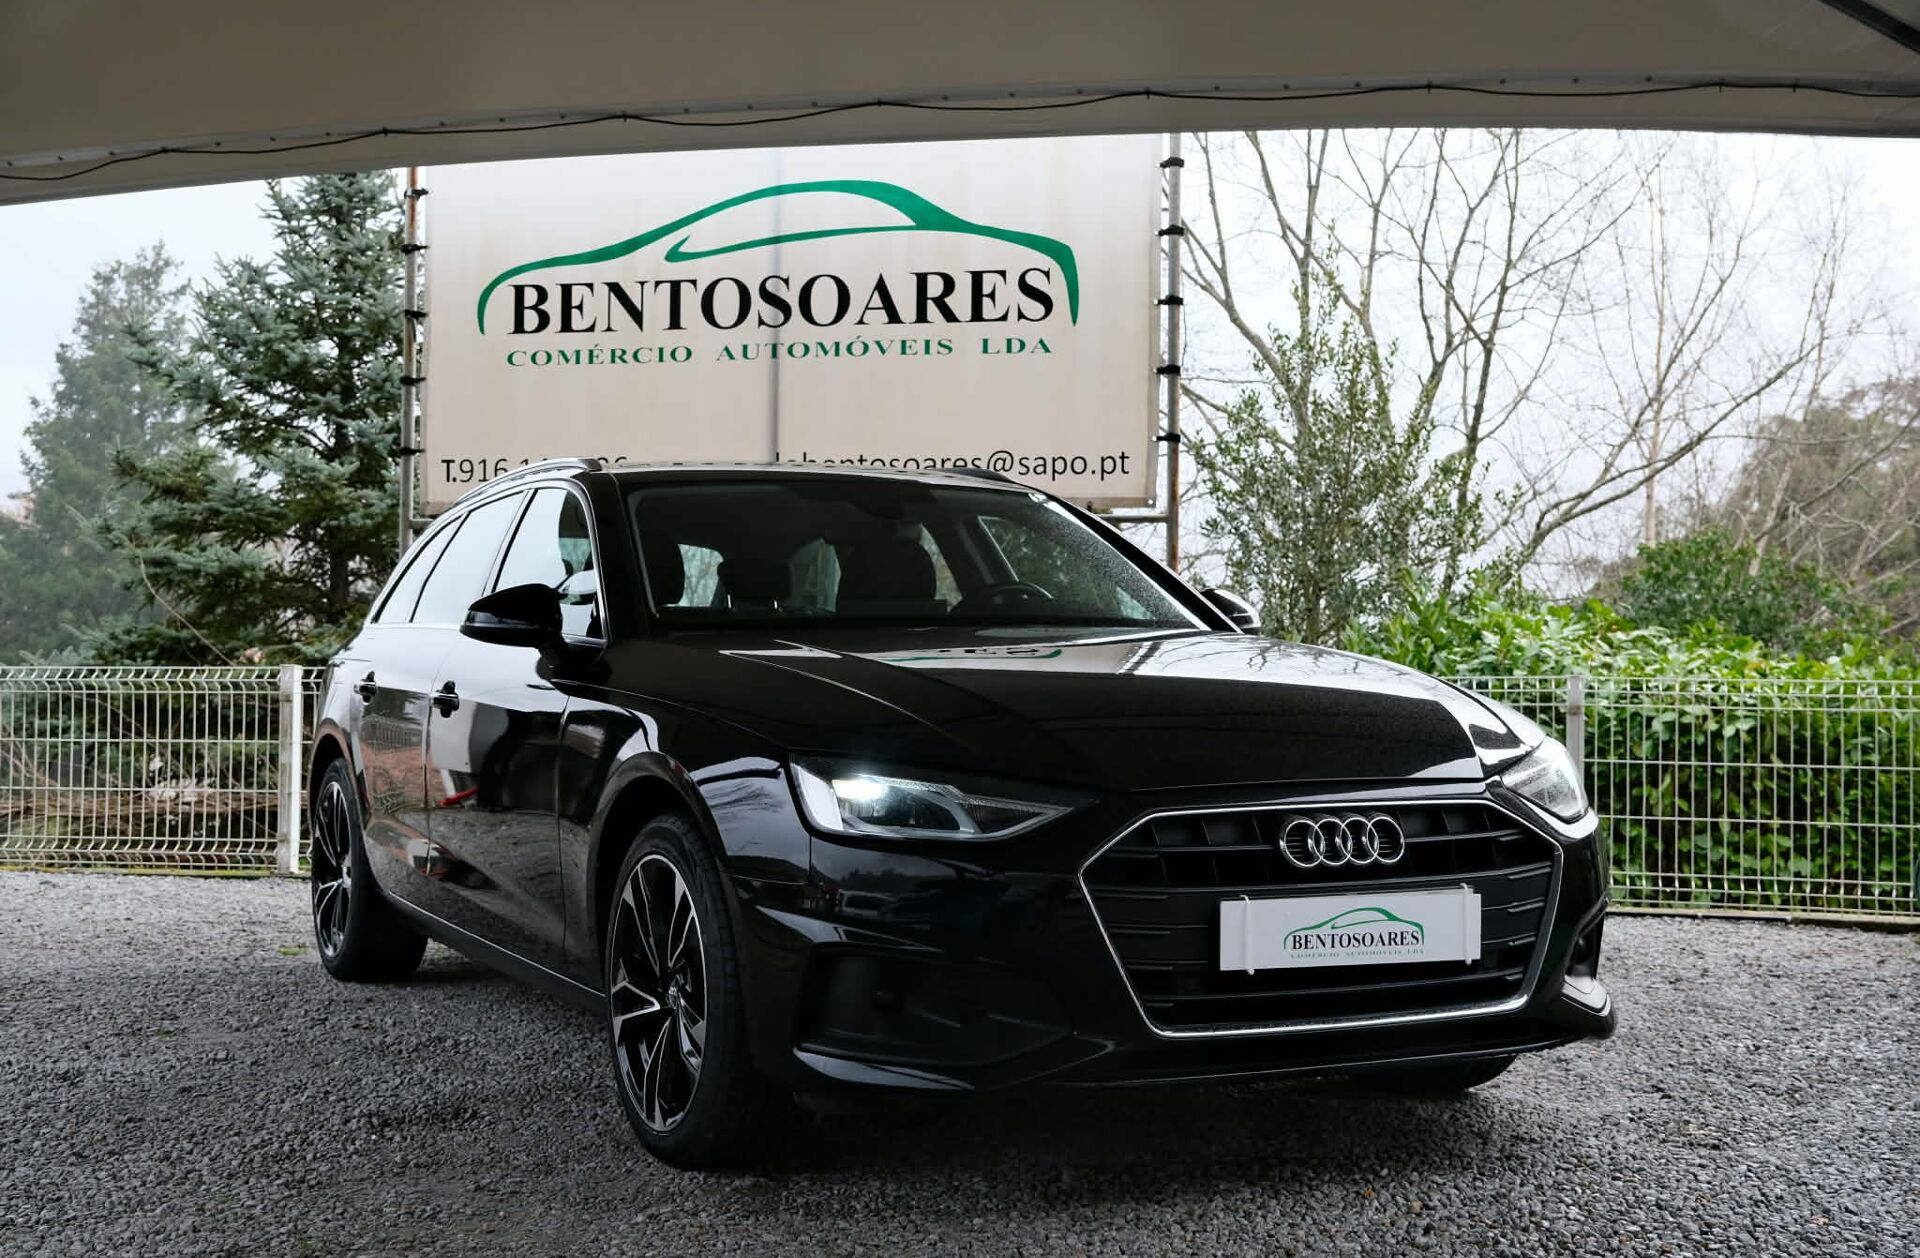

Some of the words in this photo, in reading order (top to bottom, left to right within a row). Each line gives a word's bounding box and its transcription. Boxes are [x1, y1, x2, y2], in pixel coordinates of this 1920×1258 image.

[507, 267, 1054, 335] BENTOSOARES
[507, 344, 693, 366] COMÉRCIO
[716, 336, 954, 361] AUTOMÓVEIS
[981, 337, 1053, 355] LDA
[1292, 930, 1420, 950] BENTOSOARES
